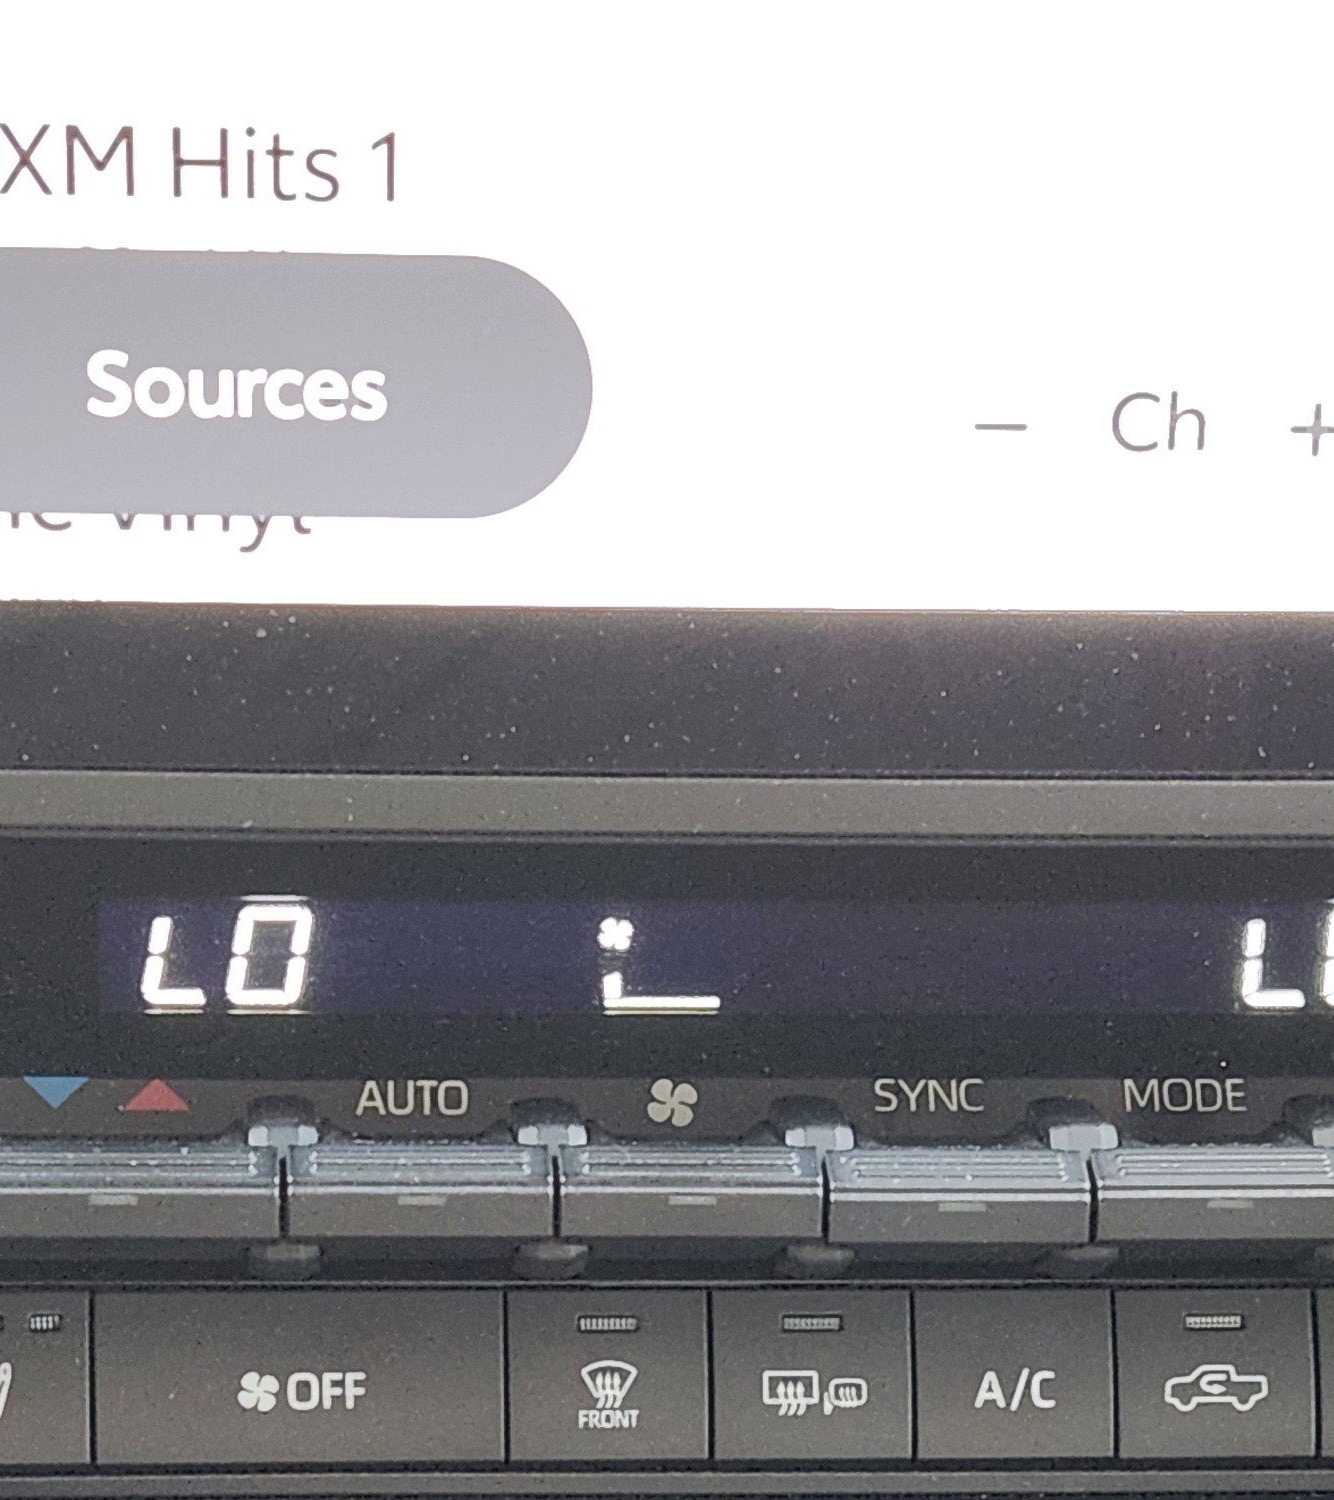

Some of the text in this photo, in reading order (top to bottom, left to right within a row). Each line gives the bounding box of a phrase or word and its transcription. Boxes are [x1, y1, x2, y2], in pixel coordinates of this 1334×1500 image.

[172, 127, 340, 202] Hits
[372, 132, 395, 202] 1
[87, 350, 387, 421] Sources
[1112, 391, 1206, 453] Ch
[357, 1080, 468, 1115] AUTO
[875, 1079, 983, 1111] SYNC
[1124, 1079, 1246, 1111] MODE
[287, 1371, 367, 1411] OFF
[975, 1368, 1056, 1411] A/C
[578, 1406, 639, 1429] FRONT
